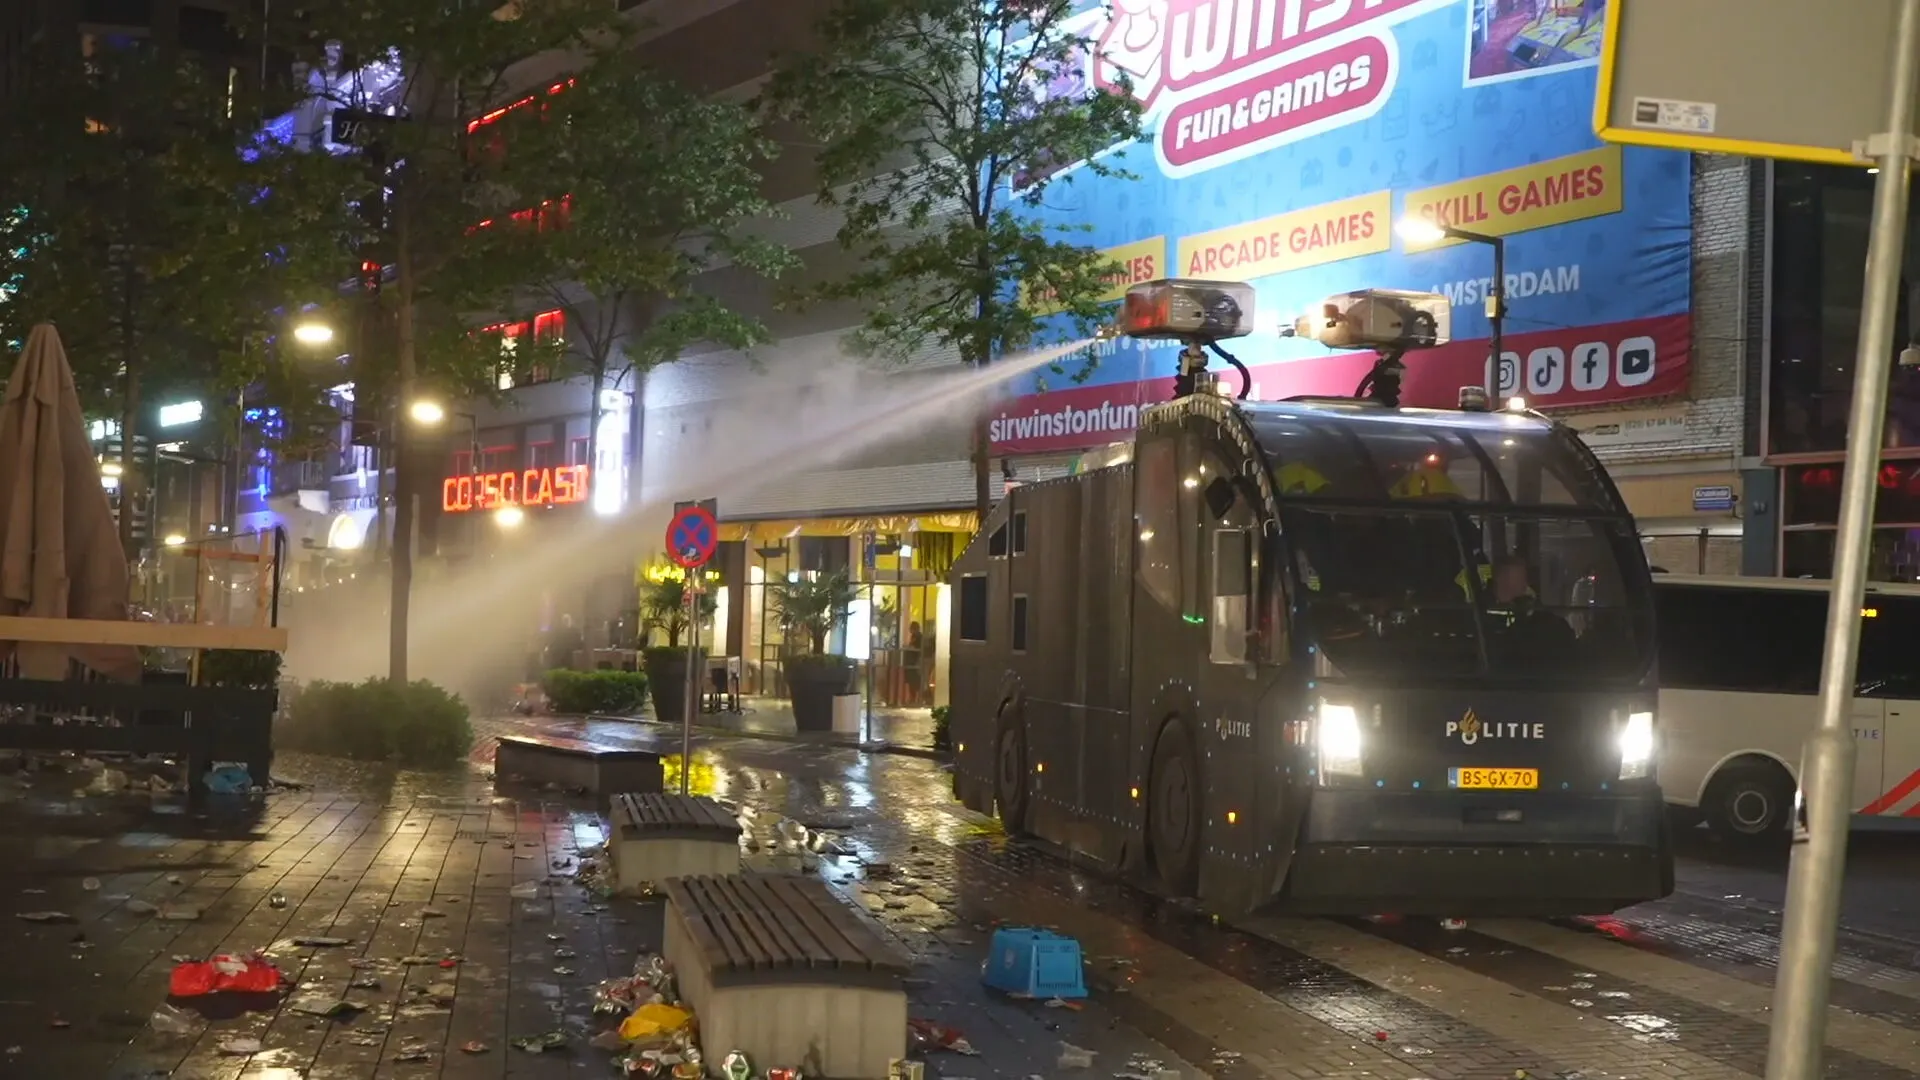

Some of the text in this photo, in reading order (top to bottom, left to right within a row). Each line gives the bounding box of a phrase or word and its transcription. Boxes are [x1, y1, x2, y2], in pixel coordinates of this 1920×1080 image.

[1420, 165, 1604, 227] SKILL GAMES
[1188, 210, 1375, 276] ARCADE GAMES
[1215, 717, 1251, 741] POLITIE
[1446, 716, 1544, 745] POLITIE
[1463, 770, 1532, 786] BS-GX-70
